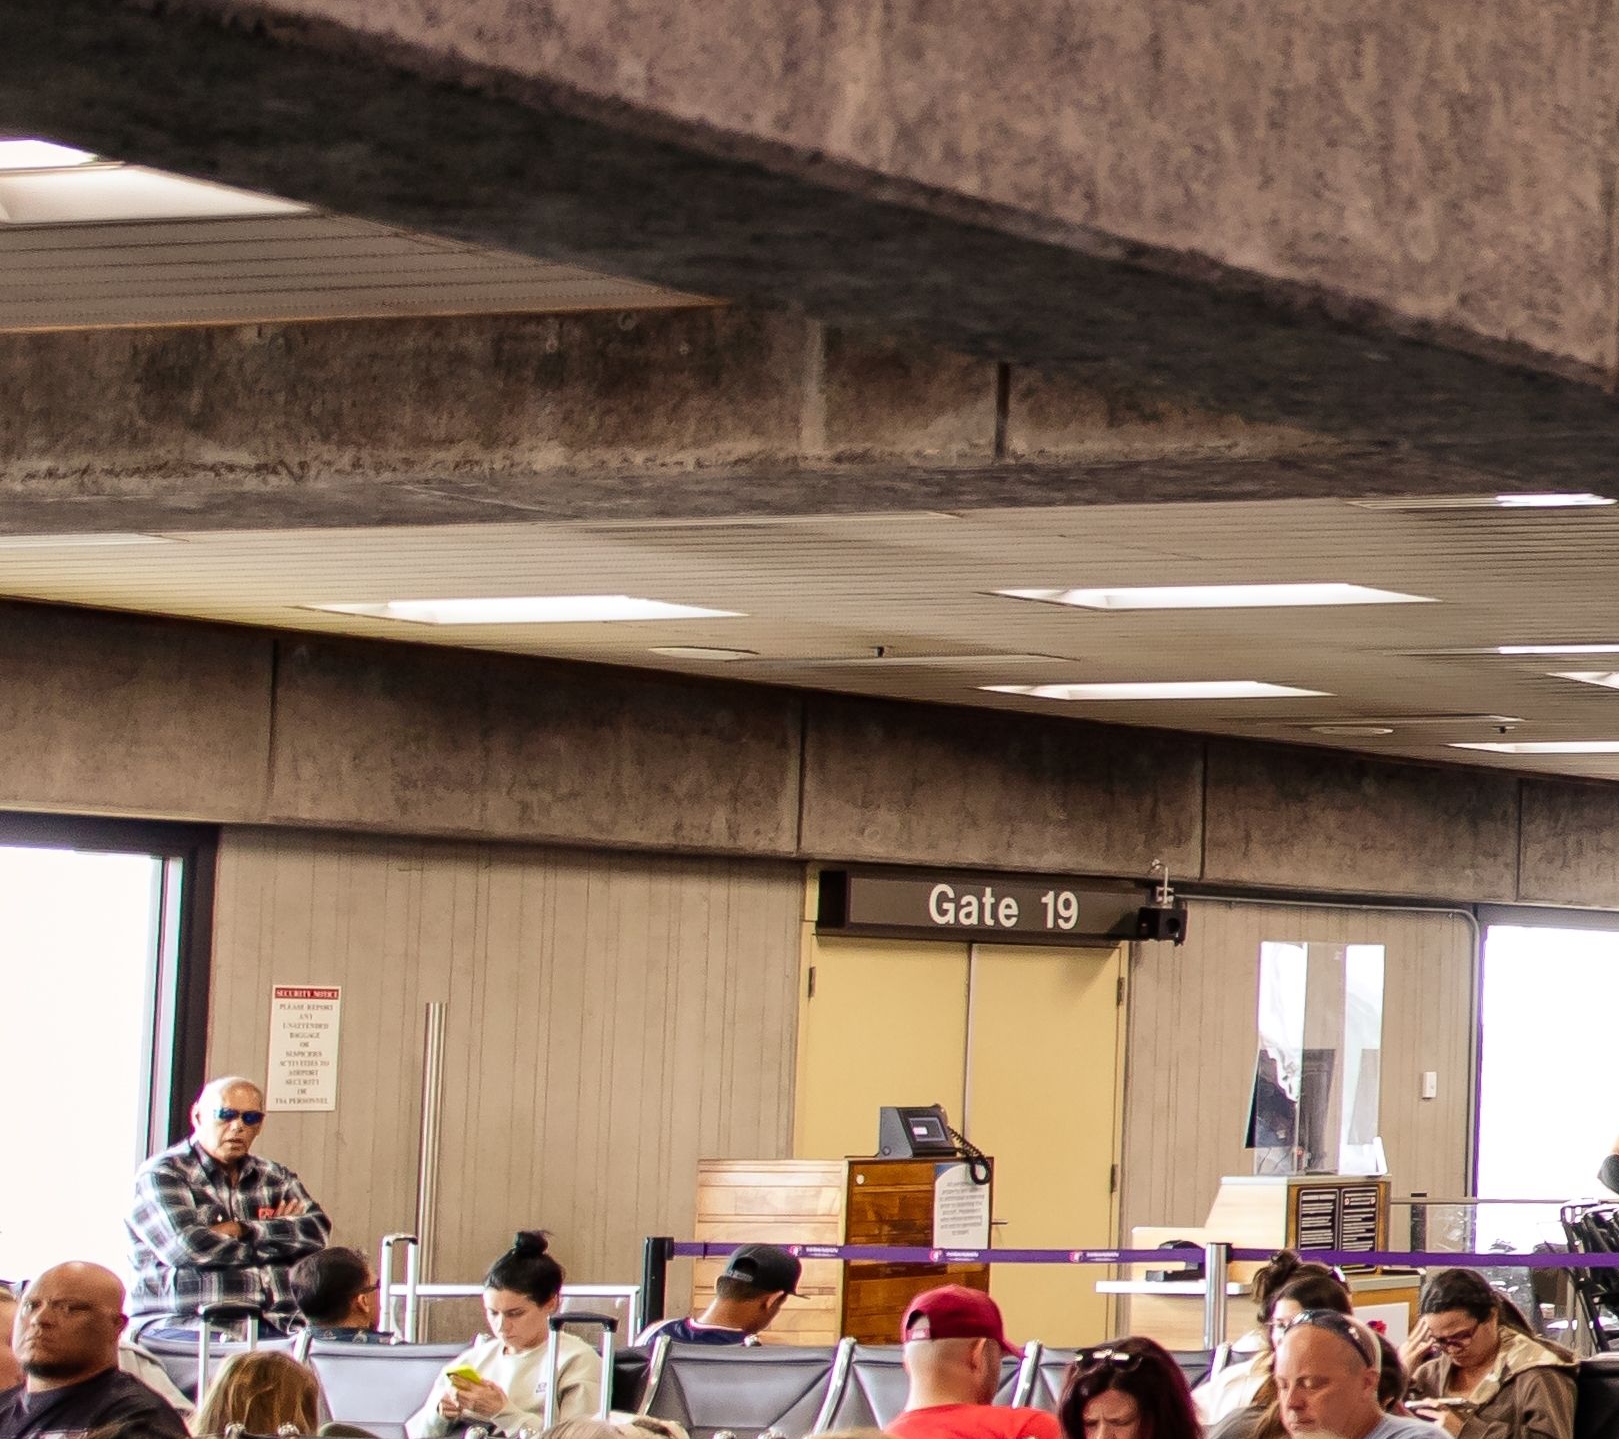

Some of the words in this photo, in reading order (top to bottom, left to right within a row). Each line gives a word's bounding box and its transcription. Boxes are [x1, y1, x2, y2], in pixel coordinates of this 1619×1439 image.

[929, 883, 1019, 927] Gate
[1041, 891, 1079, 930] 19
[277, 989, 312, 999] SECURITY
